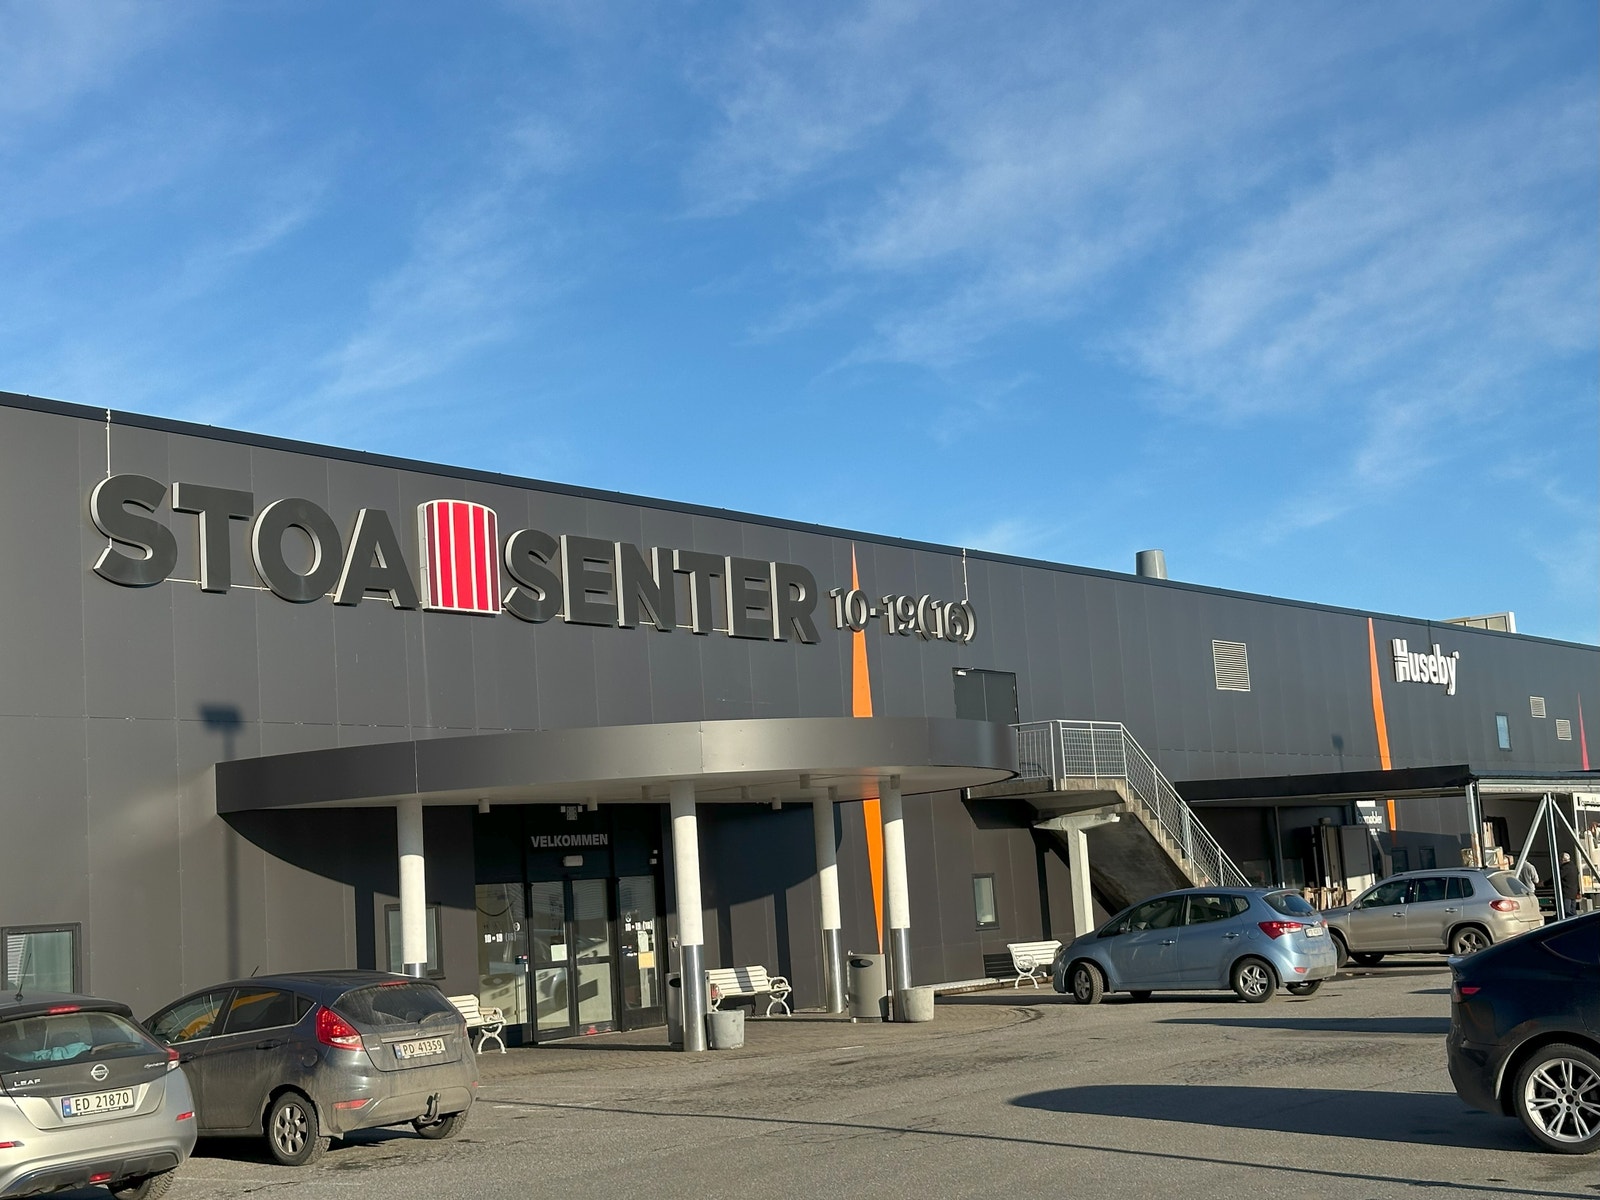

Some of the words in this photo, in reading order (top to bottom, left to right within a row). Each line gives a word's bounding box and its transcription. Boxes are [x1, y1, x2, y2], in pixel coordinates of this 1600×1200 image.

[90, 473, 419, 610] STOA
[502, 528, 821, 645] SENTER
[1391, 638, 1457, 696] Huseby
[531, 833, 609, 848] VELKOMMEN
[402, 1044, 415, 1055] PD
[418, 1039, 443, 1052] 41359
[13, 1078, 41, 1087] LEAF
[75, 1098, 91, 1111] ED
[95, 1091, 129, 1108] 21870
